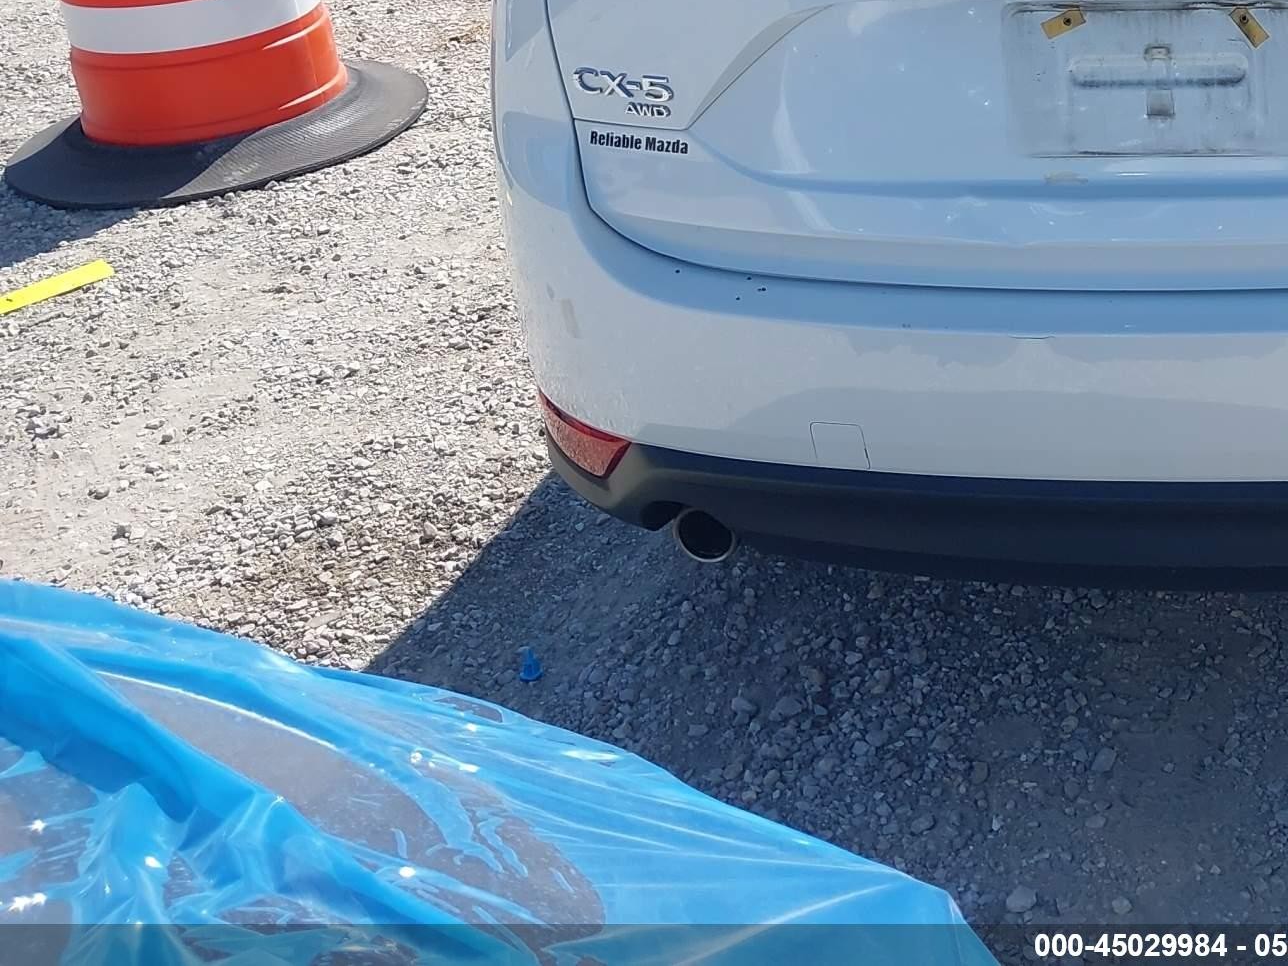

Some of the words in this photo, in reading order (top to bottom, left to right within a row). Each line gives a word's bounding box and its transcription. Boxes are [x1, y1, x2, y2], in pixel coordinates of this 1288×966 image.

[573, 67, 674, 102] CX-5
[625, 101, 672, 117] AWD
[590, 130, 642, 150] Reliable
[644, 136, 689, 155] Mazda
